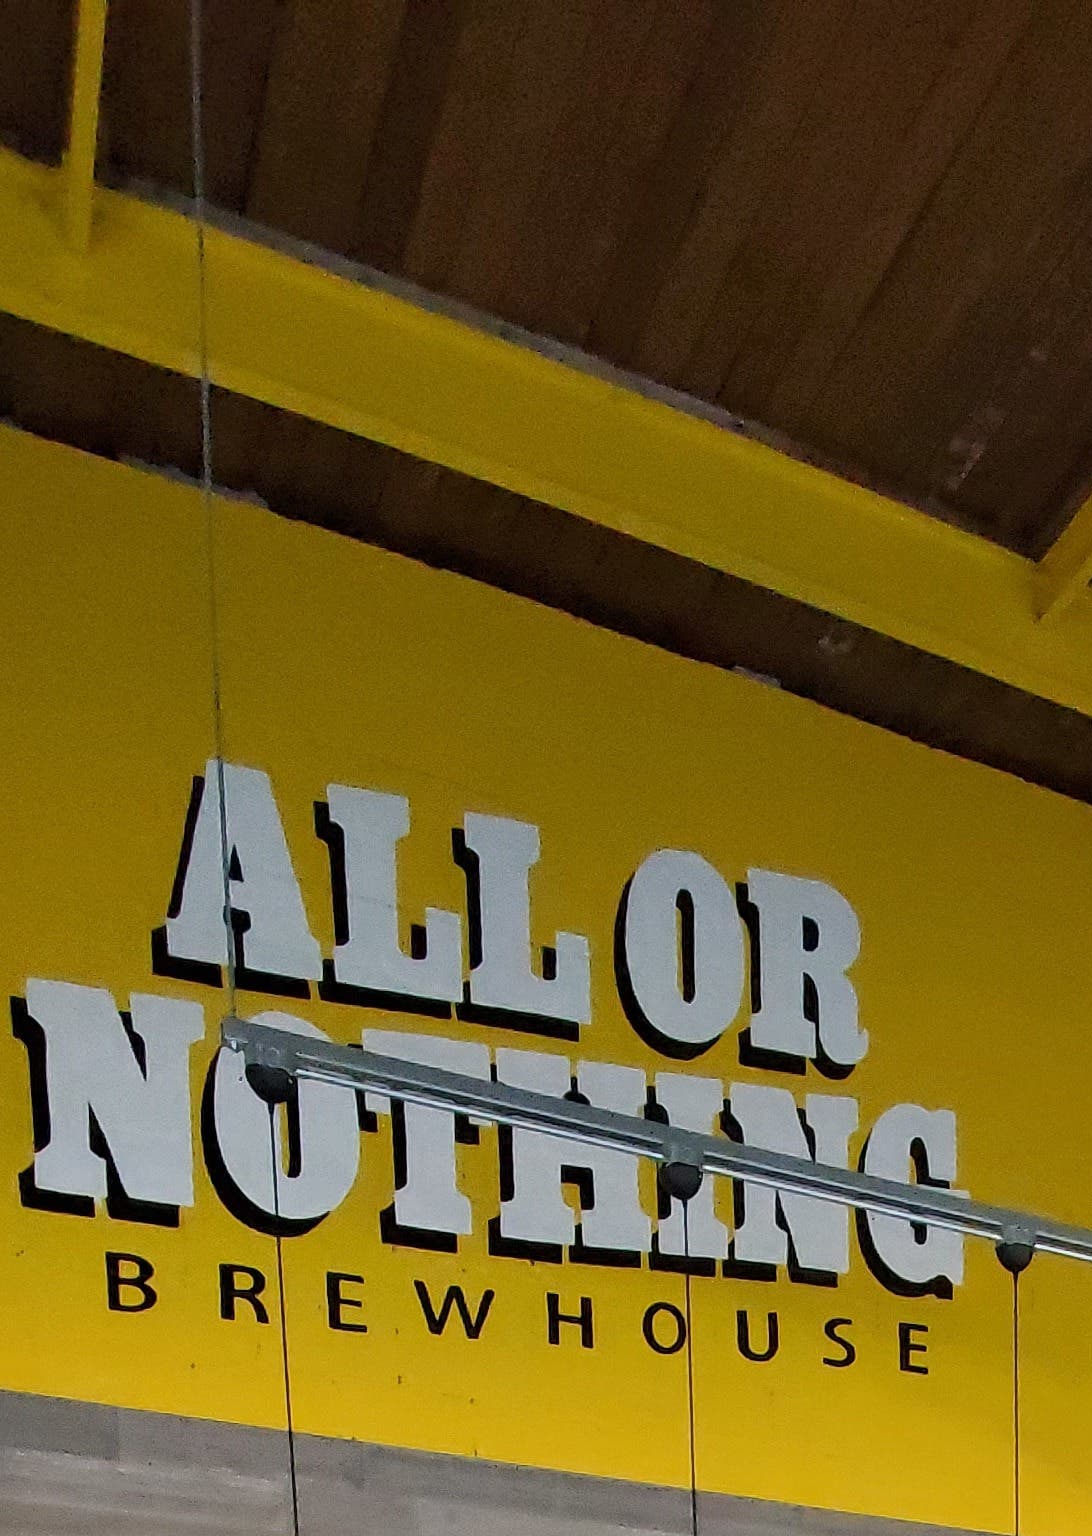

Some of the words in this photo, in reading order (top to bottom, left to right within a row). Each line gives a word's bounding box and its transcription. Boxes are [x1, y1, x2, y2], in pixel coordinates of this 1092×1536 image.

[152, 758, 591, 1041] ALL
[613, 848, 869, 1080] OR
[12, 977, 966, 1300] NOTHING
[105, 1251, 930, 1374] BREWHOUSE
